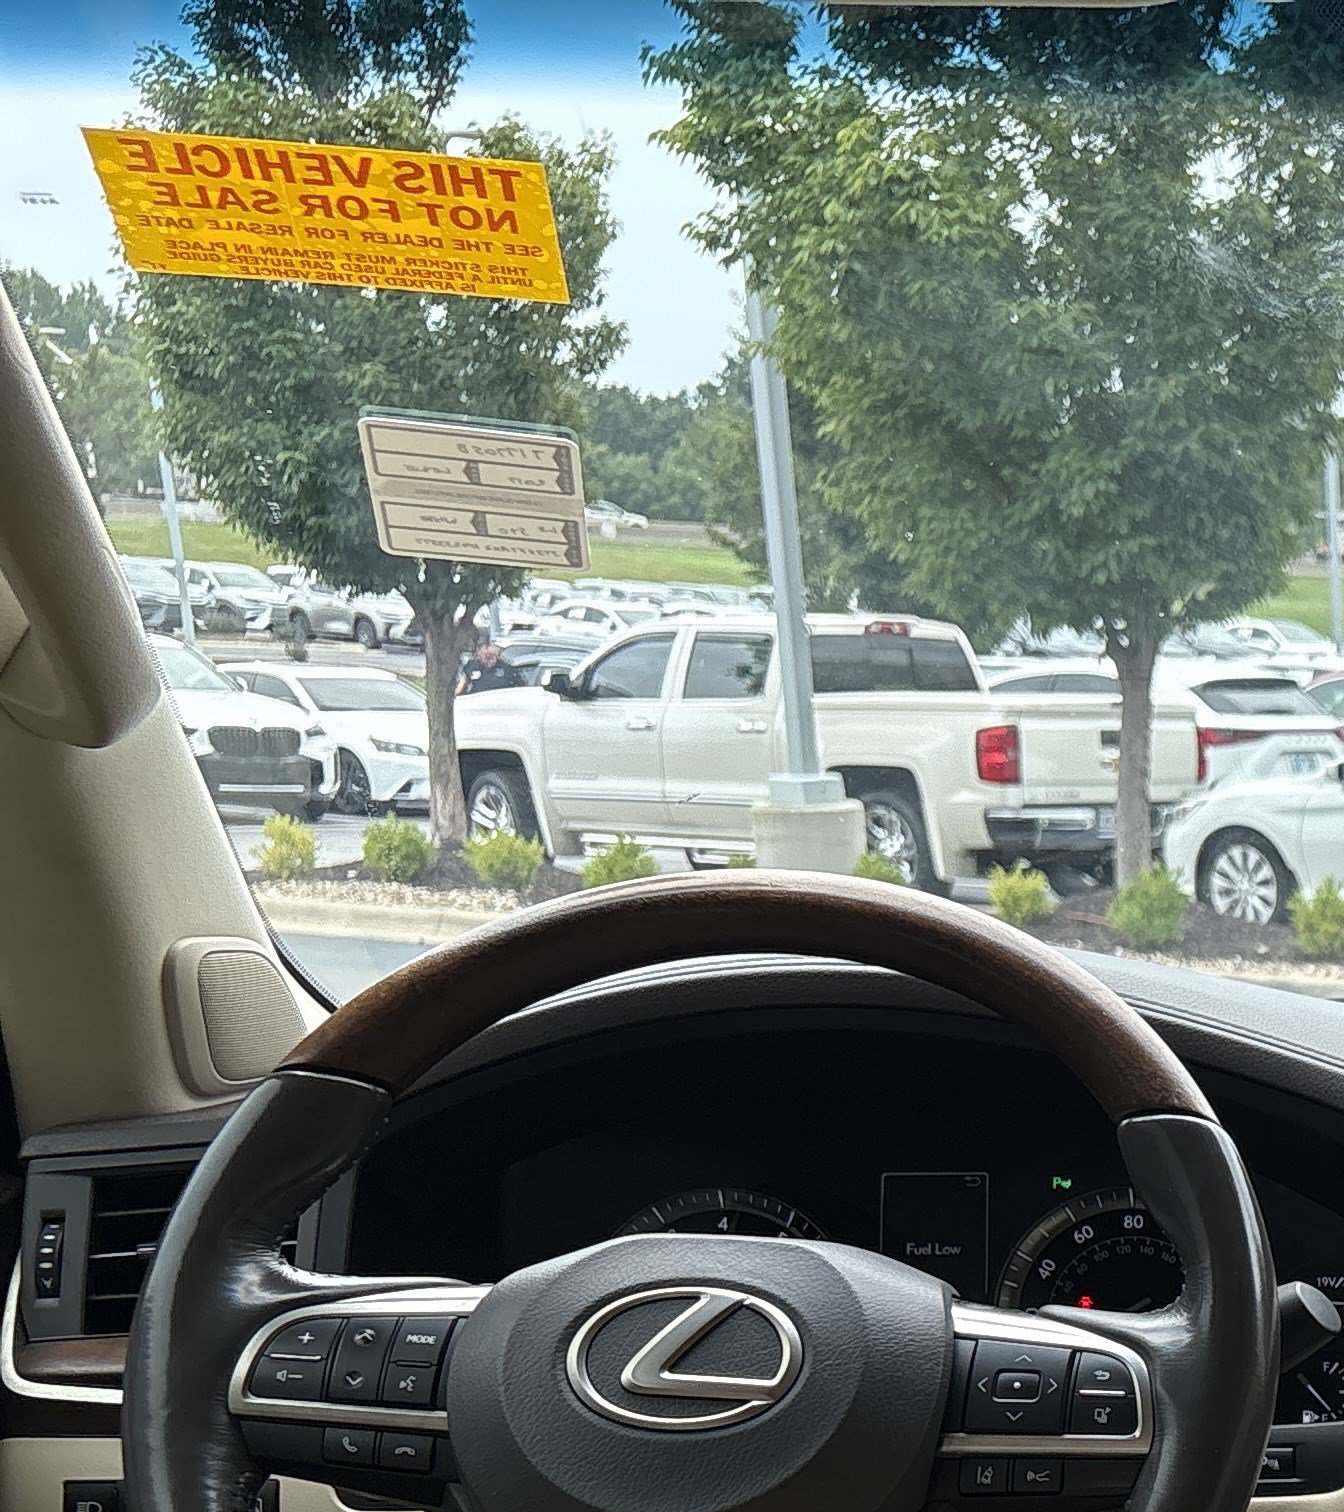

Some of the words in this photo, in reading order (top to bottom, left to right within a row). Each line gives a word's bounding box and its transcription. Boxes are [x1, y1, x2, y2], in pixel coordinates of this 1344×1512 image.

[718, 1217, 728, 1231] 4
[1123, 1215, 1144, 1229] 80
[1073, 1225, 1094, 1243] 60
[906, 1243, 931, 1255] Fuel
[935, 1243, 961, 1255] Low
[1116, 1245, 1132, 1254] 120
[1140, 1246, 1155, 1255] 140
[1038, 1259, 1056, 1280] 40
[406, 1334, 436, 1344] MODE
[1323, 1361, 1330, 1372] F
